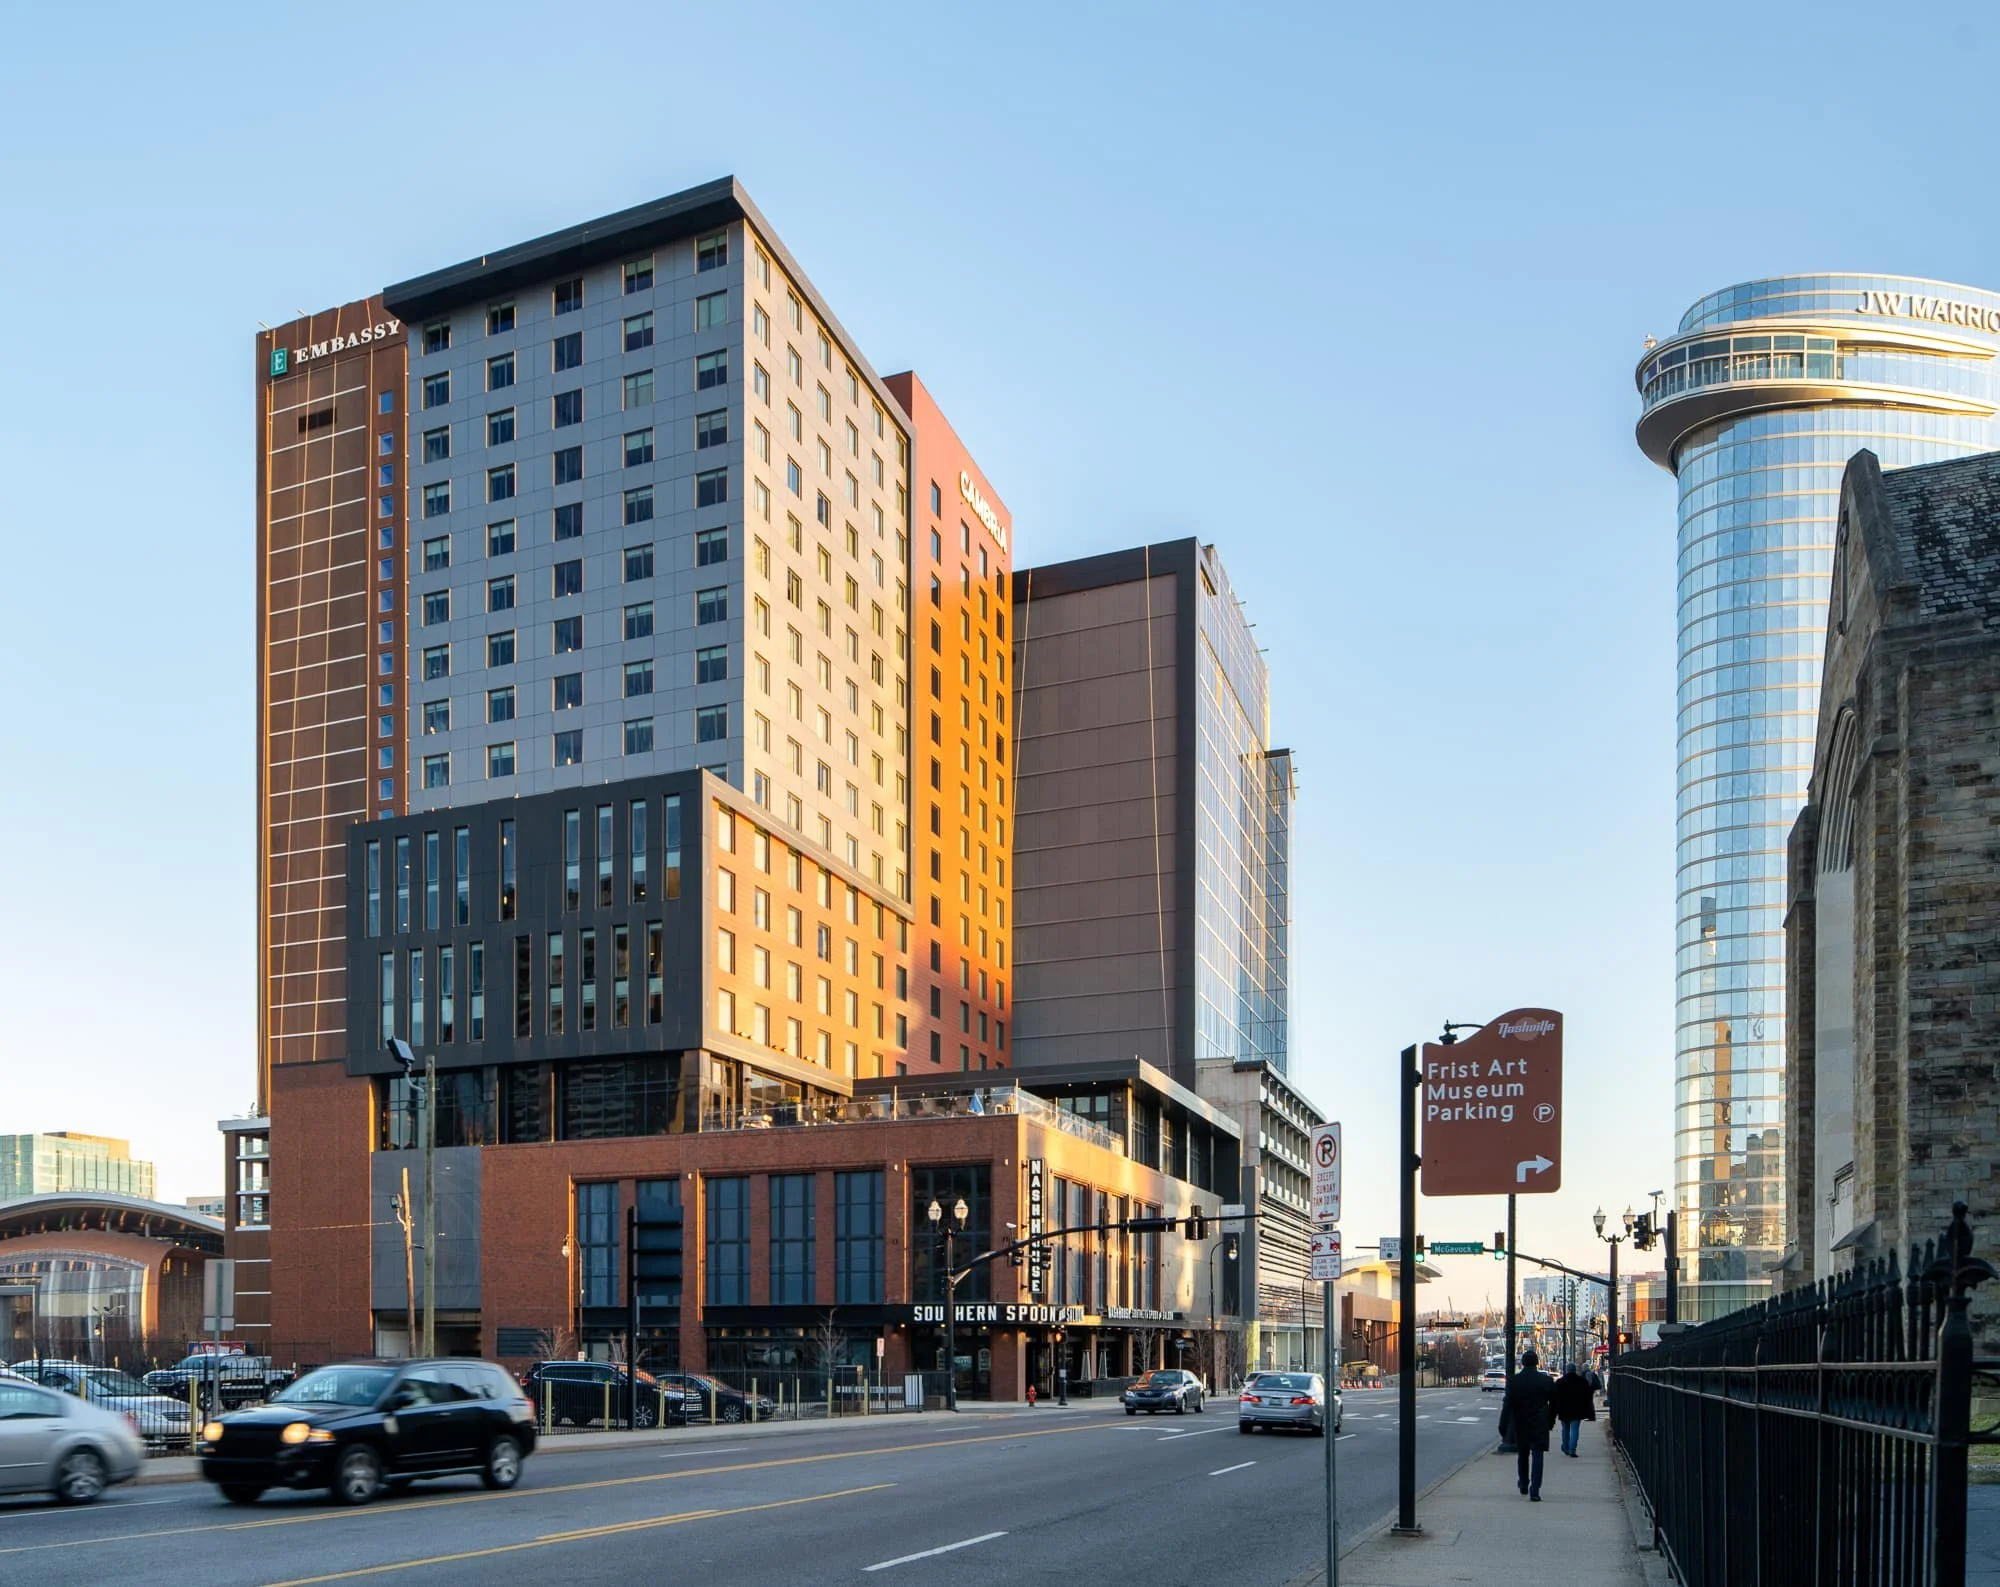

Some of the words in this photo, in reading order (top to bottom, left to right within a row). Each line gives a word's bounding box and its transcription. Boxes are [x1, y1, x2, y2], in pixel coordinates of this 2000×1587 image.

[1856, 291, 1906, 315] JW
[293, 319, 401, 364] EMBASSY
[960, 469, 1008, 555] CAMBRIA
[1498, 1020, 1556, 1038] Nashville
[1427, 1061, 1480, 1080] Frist
[1488, 1058, 1528, 1077] Art
[1427, 1082, 1525, 1100] Museum
[1427, 1102, 1514, 1122] Parking
[1316, 1183, 1336, 1195] SUNDAY
[1434, 1245, 1472, 1253] McGavock
[913, 1305, 998, 1322] SOUHERN
[1006, 1305, 1056, 1322] SPOON
